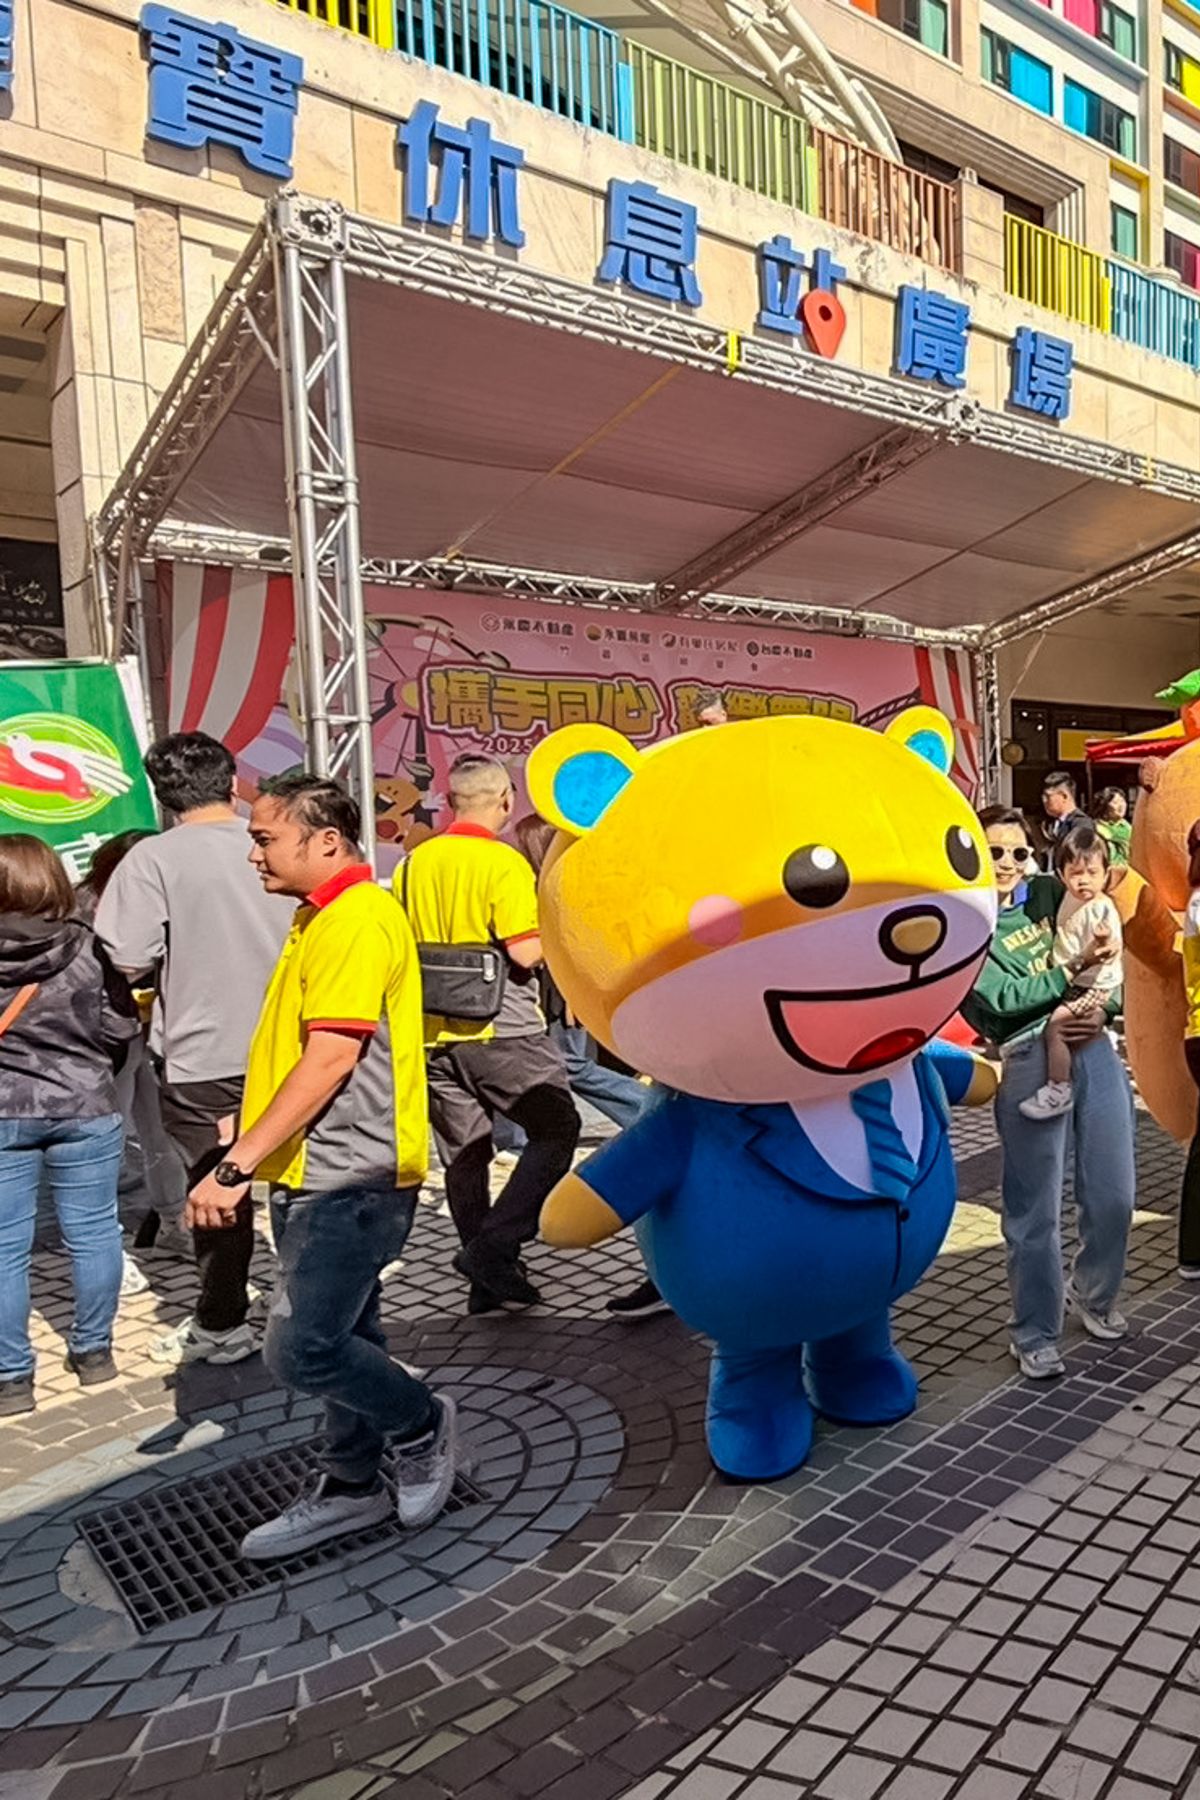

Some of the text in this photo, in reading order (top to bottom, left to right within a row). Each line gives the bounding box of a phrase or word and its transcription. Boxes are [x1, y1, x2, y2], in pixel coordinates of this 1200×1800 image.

[0, 0, 1073, 421] 寶休息站廣場
[428, 667, 661, 734] 攜手同心
